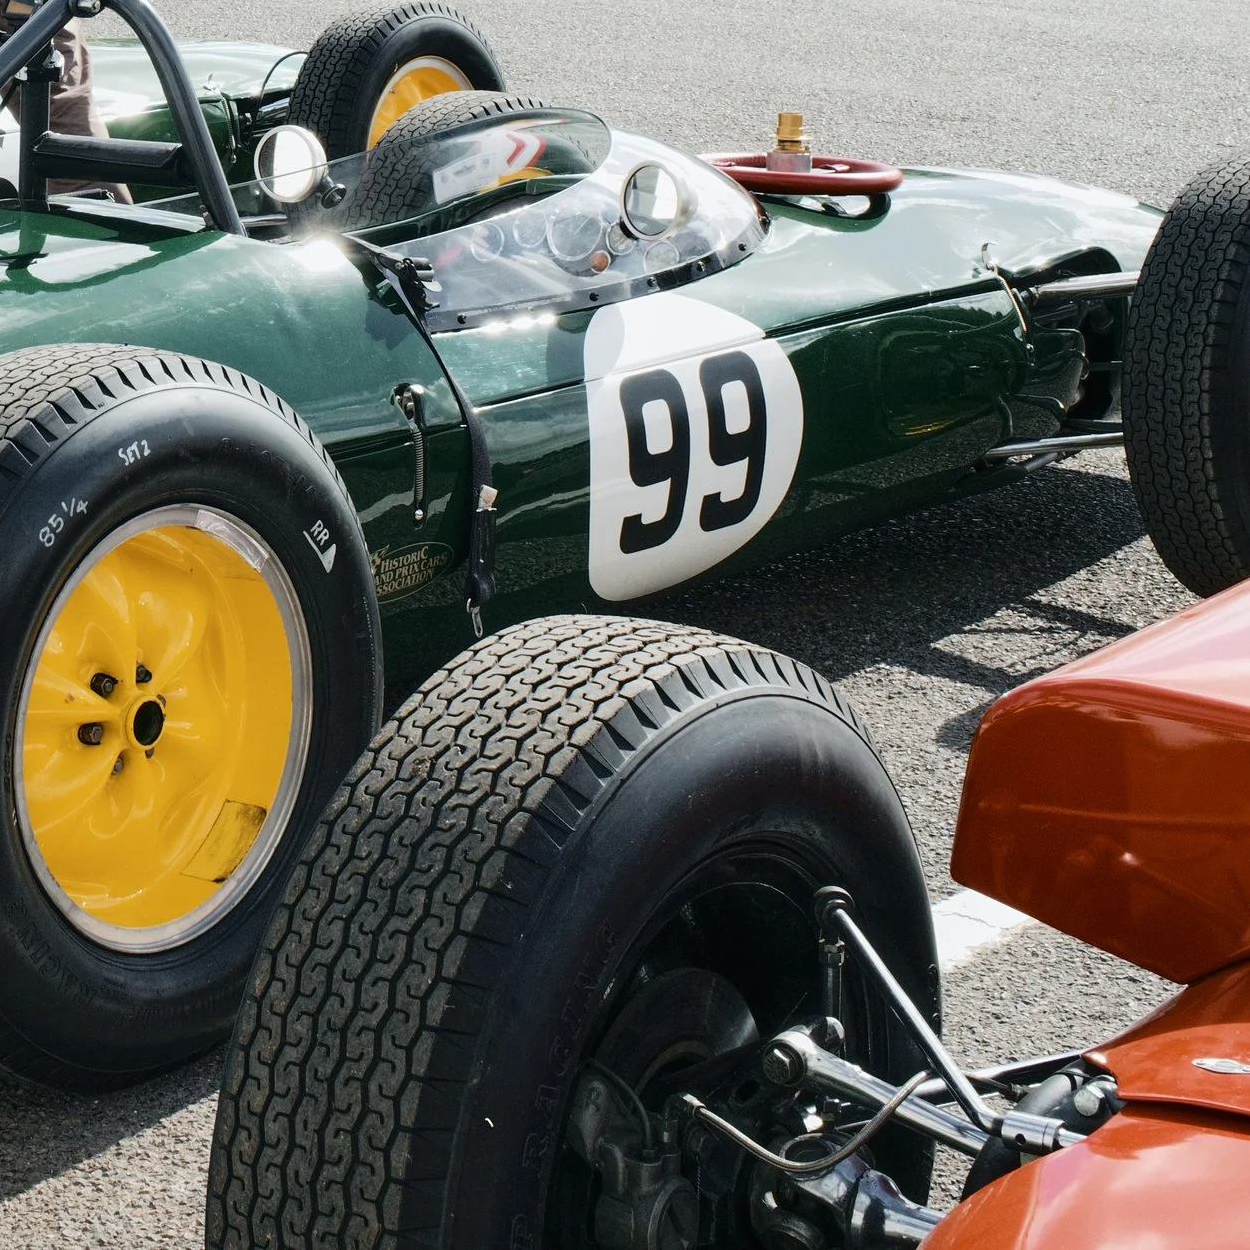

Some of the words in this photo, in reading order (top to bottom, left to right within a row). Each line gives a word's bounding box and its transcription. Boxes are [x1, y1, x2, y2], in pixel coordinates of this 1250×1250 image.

[117, 440, 141, 467] SET
[140, 438, 152, 457] 2
[617, 350, 767, 554] 99
[38, 513, 65, 548] 85
[60, 497, 89, 518] 1/4
[308, 519, 330, 547] RR
[373, 571, 394, 586] AND
[395, 562, 421, 579] PRIX
[420, 552, 448, 571] CARS
[380, 546, 429, 573] HISTORIC
[376, 568, 434, 596] SSOCIATION
